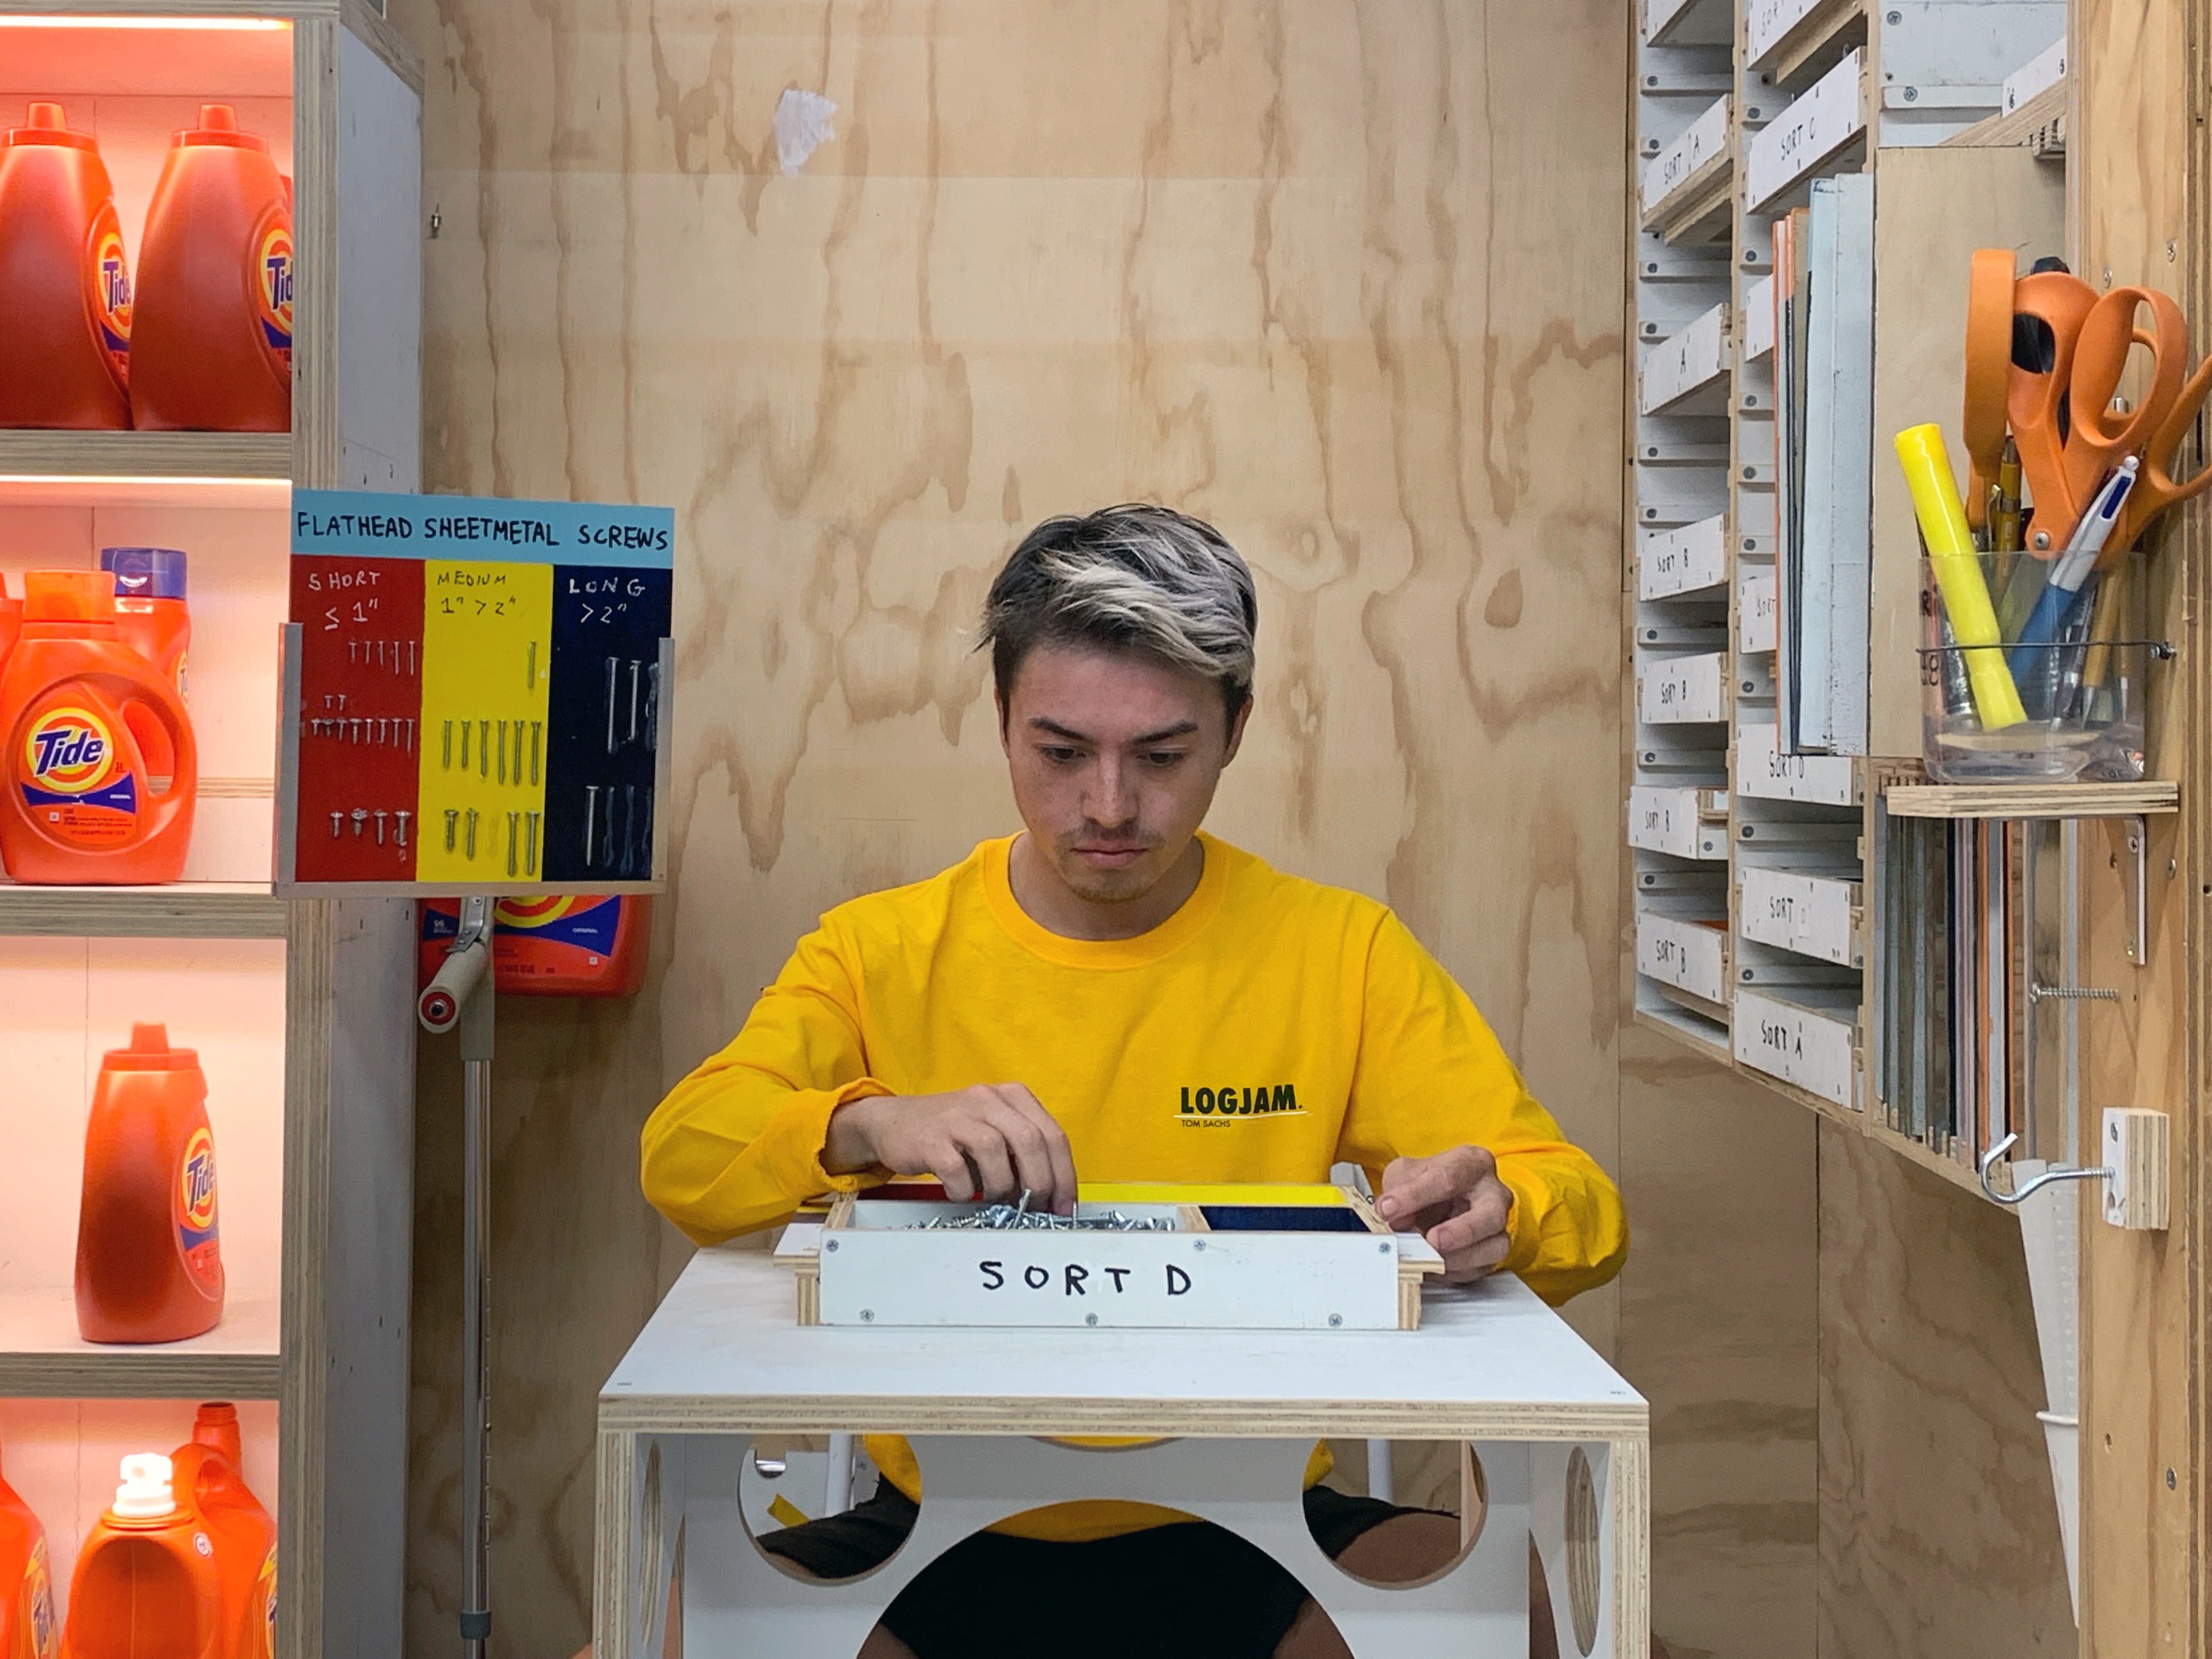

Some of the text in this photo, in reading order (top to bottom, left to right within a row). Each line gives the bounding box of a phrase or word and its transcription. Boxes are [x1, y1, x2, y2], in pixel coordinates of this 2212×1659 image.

[1761, 0, 1784, 36] SOR
[1781, 117, 1816, 161] SORT C
[1664, 134, 1700, 185] SORT A
[103, 261, 131, 313] Tide
[267, 257, 293, 310] Tid
[298, 512, 668, 550] FLATHEAD SHEETMETAL SCREWS
[309, 570, 381, 591] SHORT
[437, 570, 506, 587] MEDIUM
[1657, 554, 1674, 573] SORT
[569, 576, 646, 597] LONG
[1661, 682, 1676, 704] SORT
[35, 729, 104, 776] Tide
[1769, 750, 1792, 777] SORT
[1646, 810, 1658, 830] SORT
[1770, 896, 1793, 923] SORT
[1656, 939, 1686, 973] SORT B
[1761, 1019, 1802, 1060] SORT A
[1180, 1084, 1302, 1114] LOGJAM.
[188, 1154, 214, 1213] Tide
[980, 1261, 1192, 1296] SORT D
